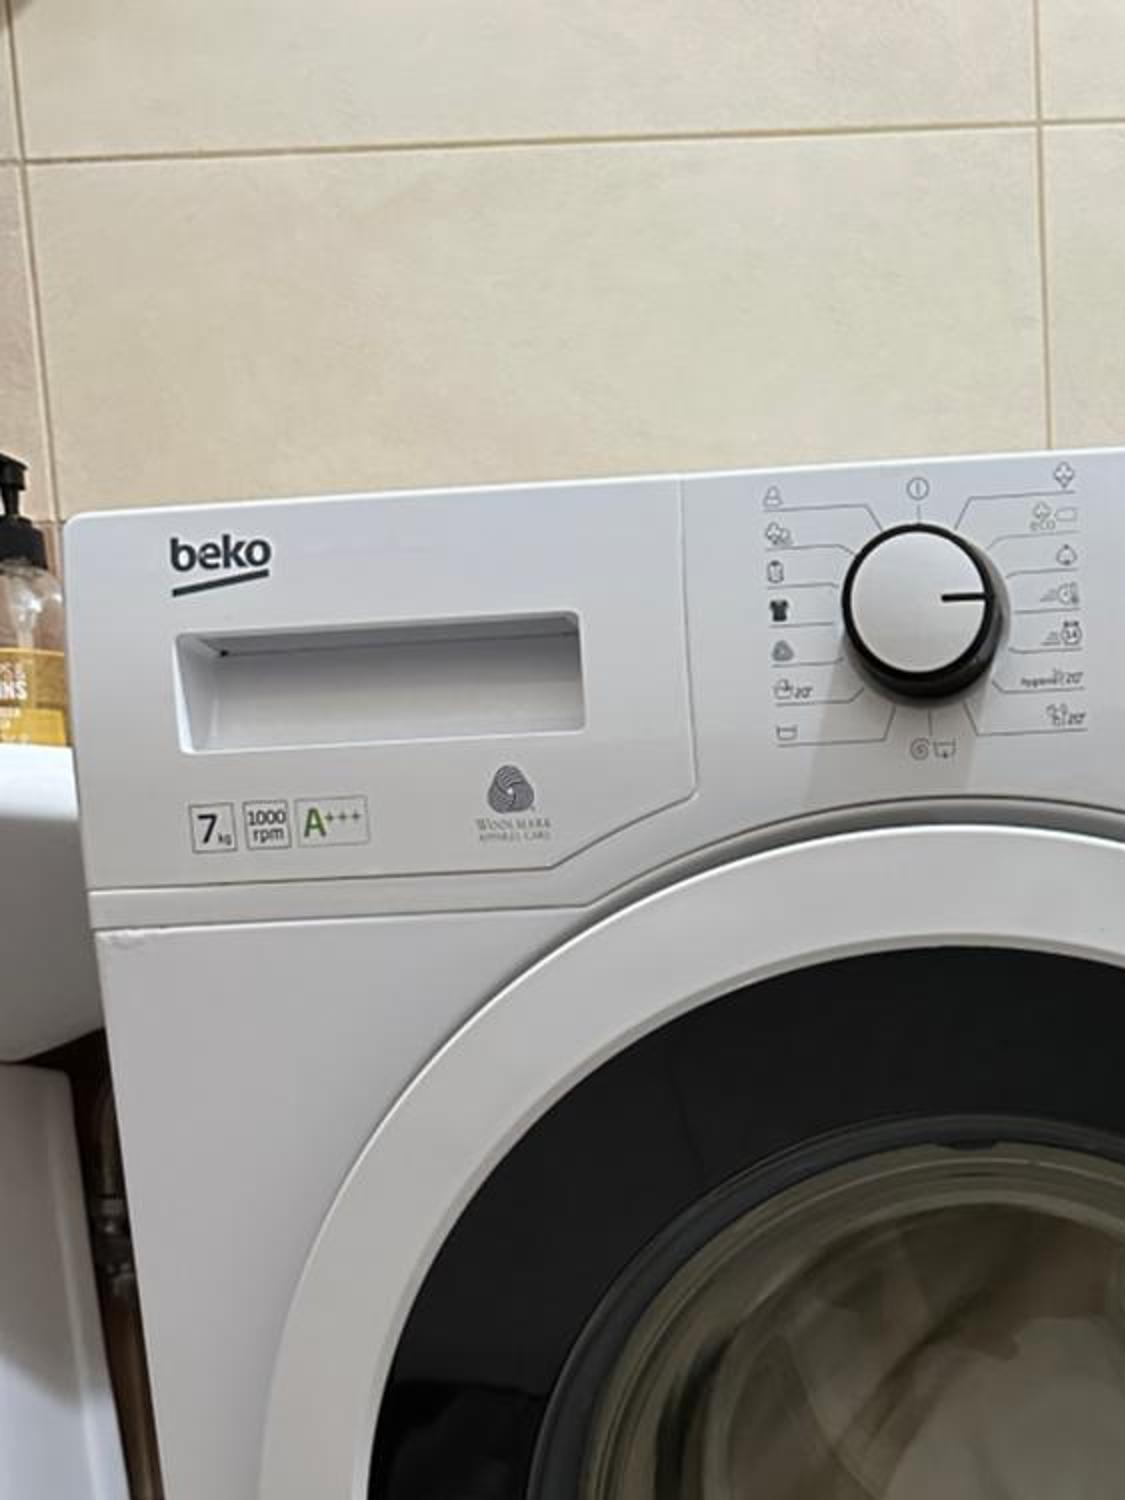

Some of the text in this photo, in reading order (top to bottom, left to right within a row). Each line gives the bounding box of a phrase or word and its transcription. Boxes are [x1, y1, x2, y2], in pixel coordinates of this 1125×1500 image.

[170, 534, 272, 572] beko
[198, 813, 217, 844] 7
[249, 809, 286, 826] 1000
[304, 807, 361, 837] A+++
[253, 827, 284, 843] rpm
